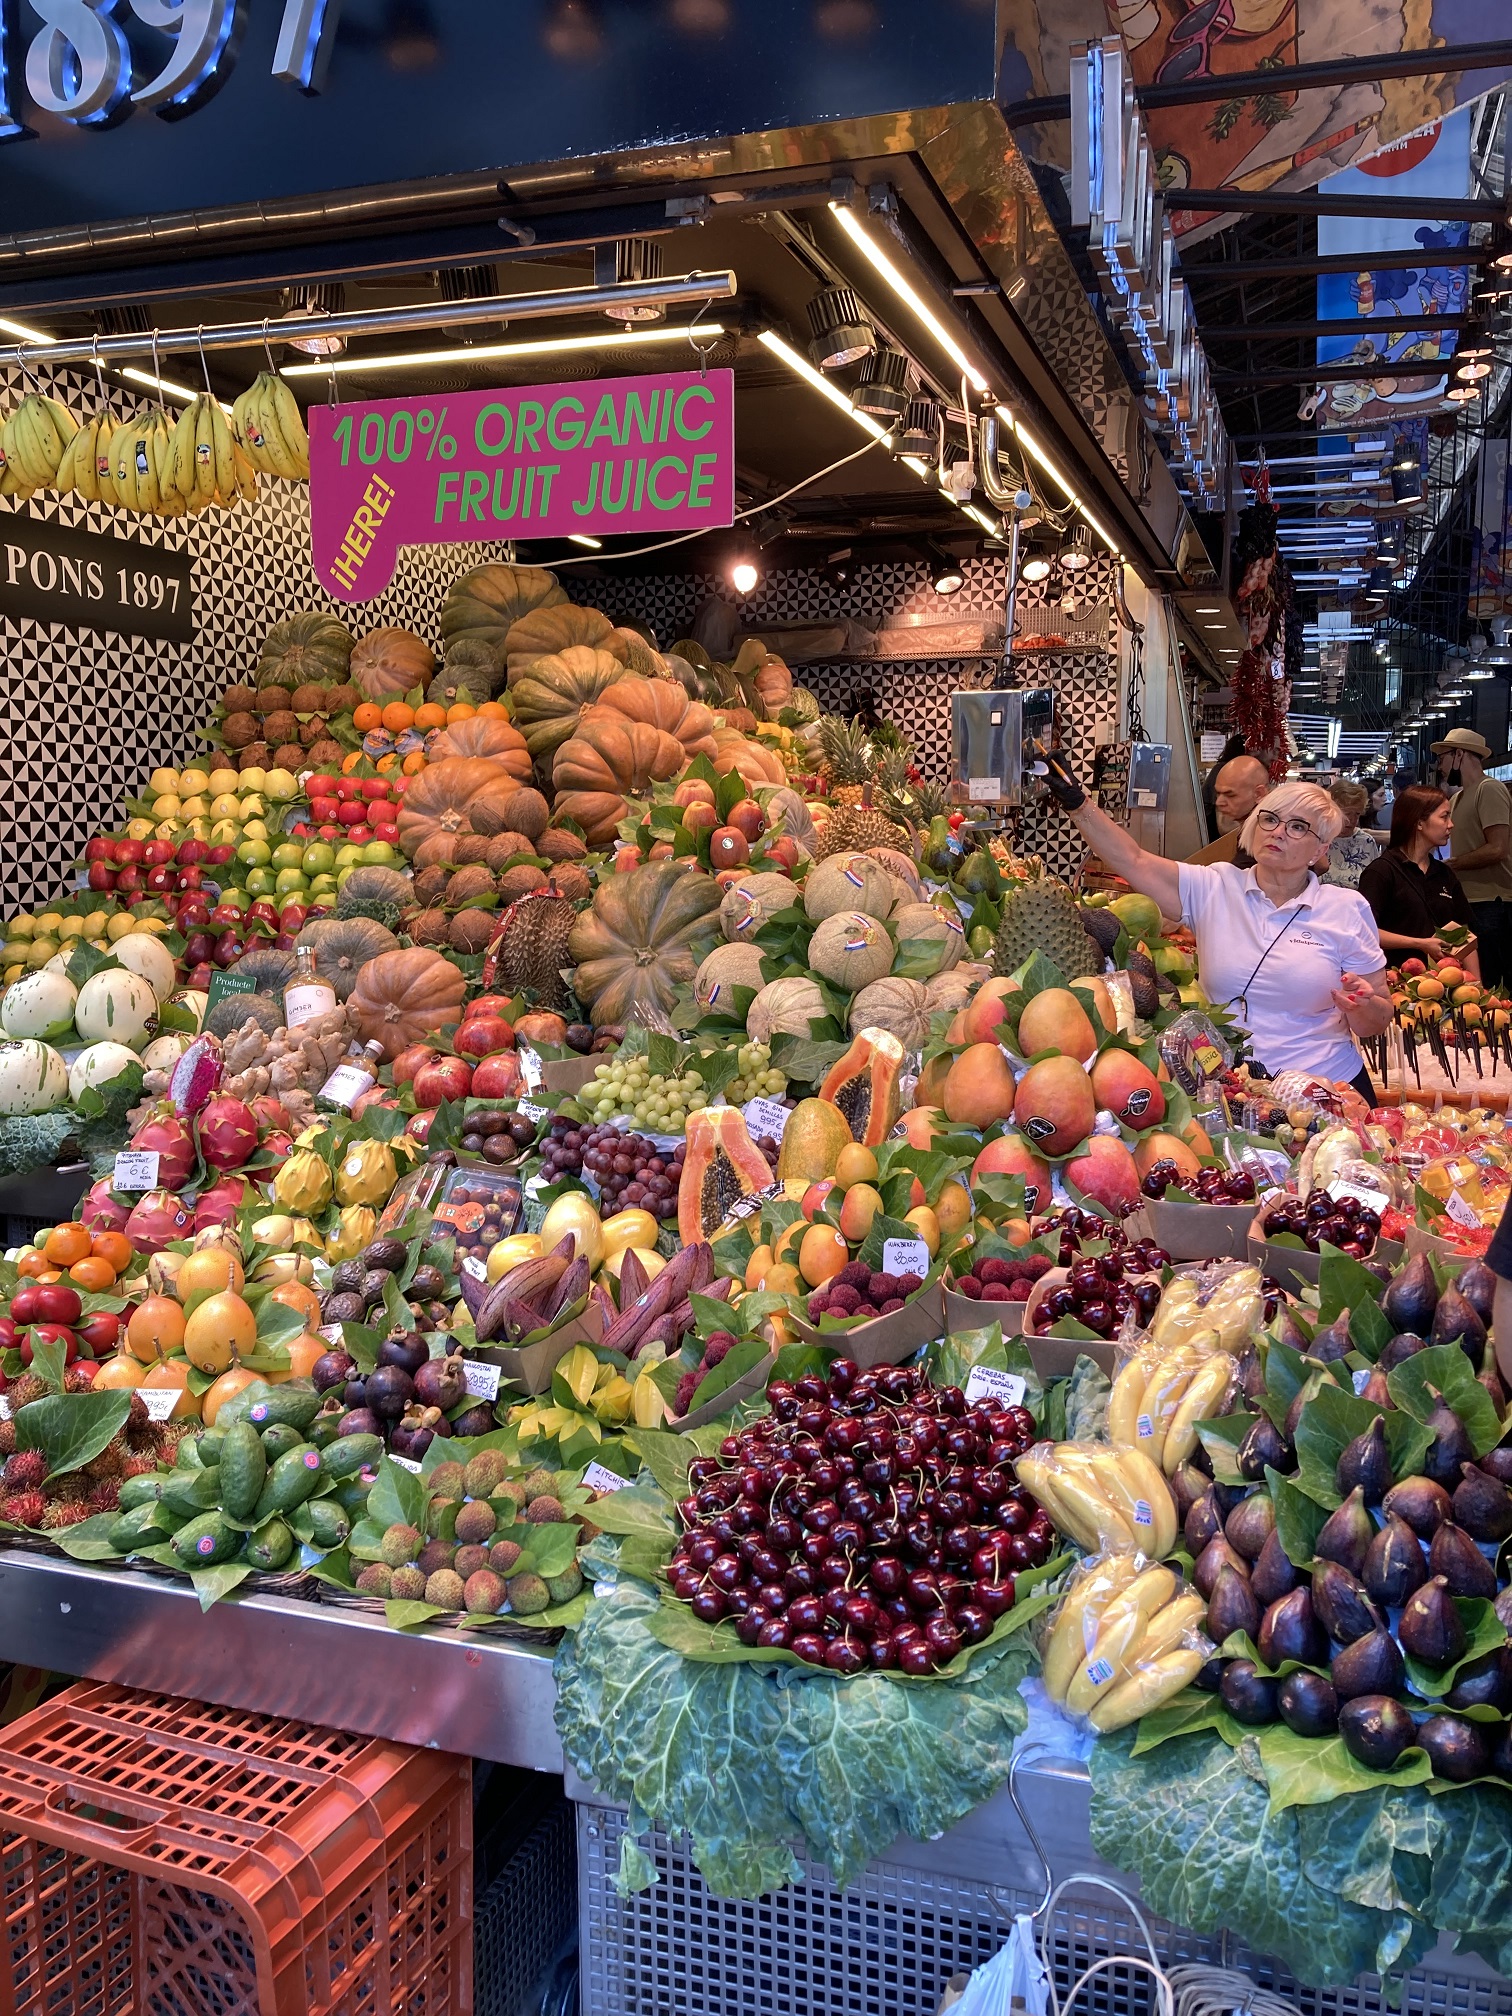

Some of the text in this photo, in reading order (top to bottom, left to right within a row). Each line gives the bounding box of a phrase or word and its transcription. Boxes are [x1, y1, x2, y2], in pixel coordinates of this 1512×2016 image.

[332, 385, 717, 466] 100% ORGANIC
[434, 452, 718, 524] FRUIT JUICE
[329, 473, 396, 591] ¡HERE!
[3, 543, 180, 614] PONS 1897
[215, 975, 252, 990] Producte
[129, 1164, 139, 1176] 6
[917, 1264, 926, 1275] €
